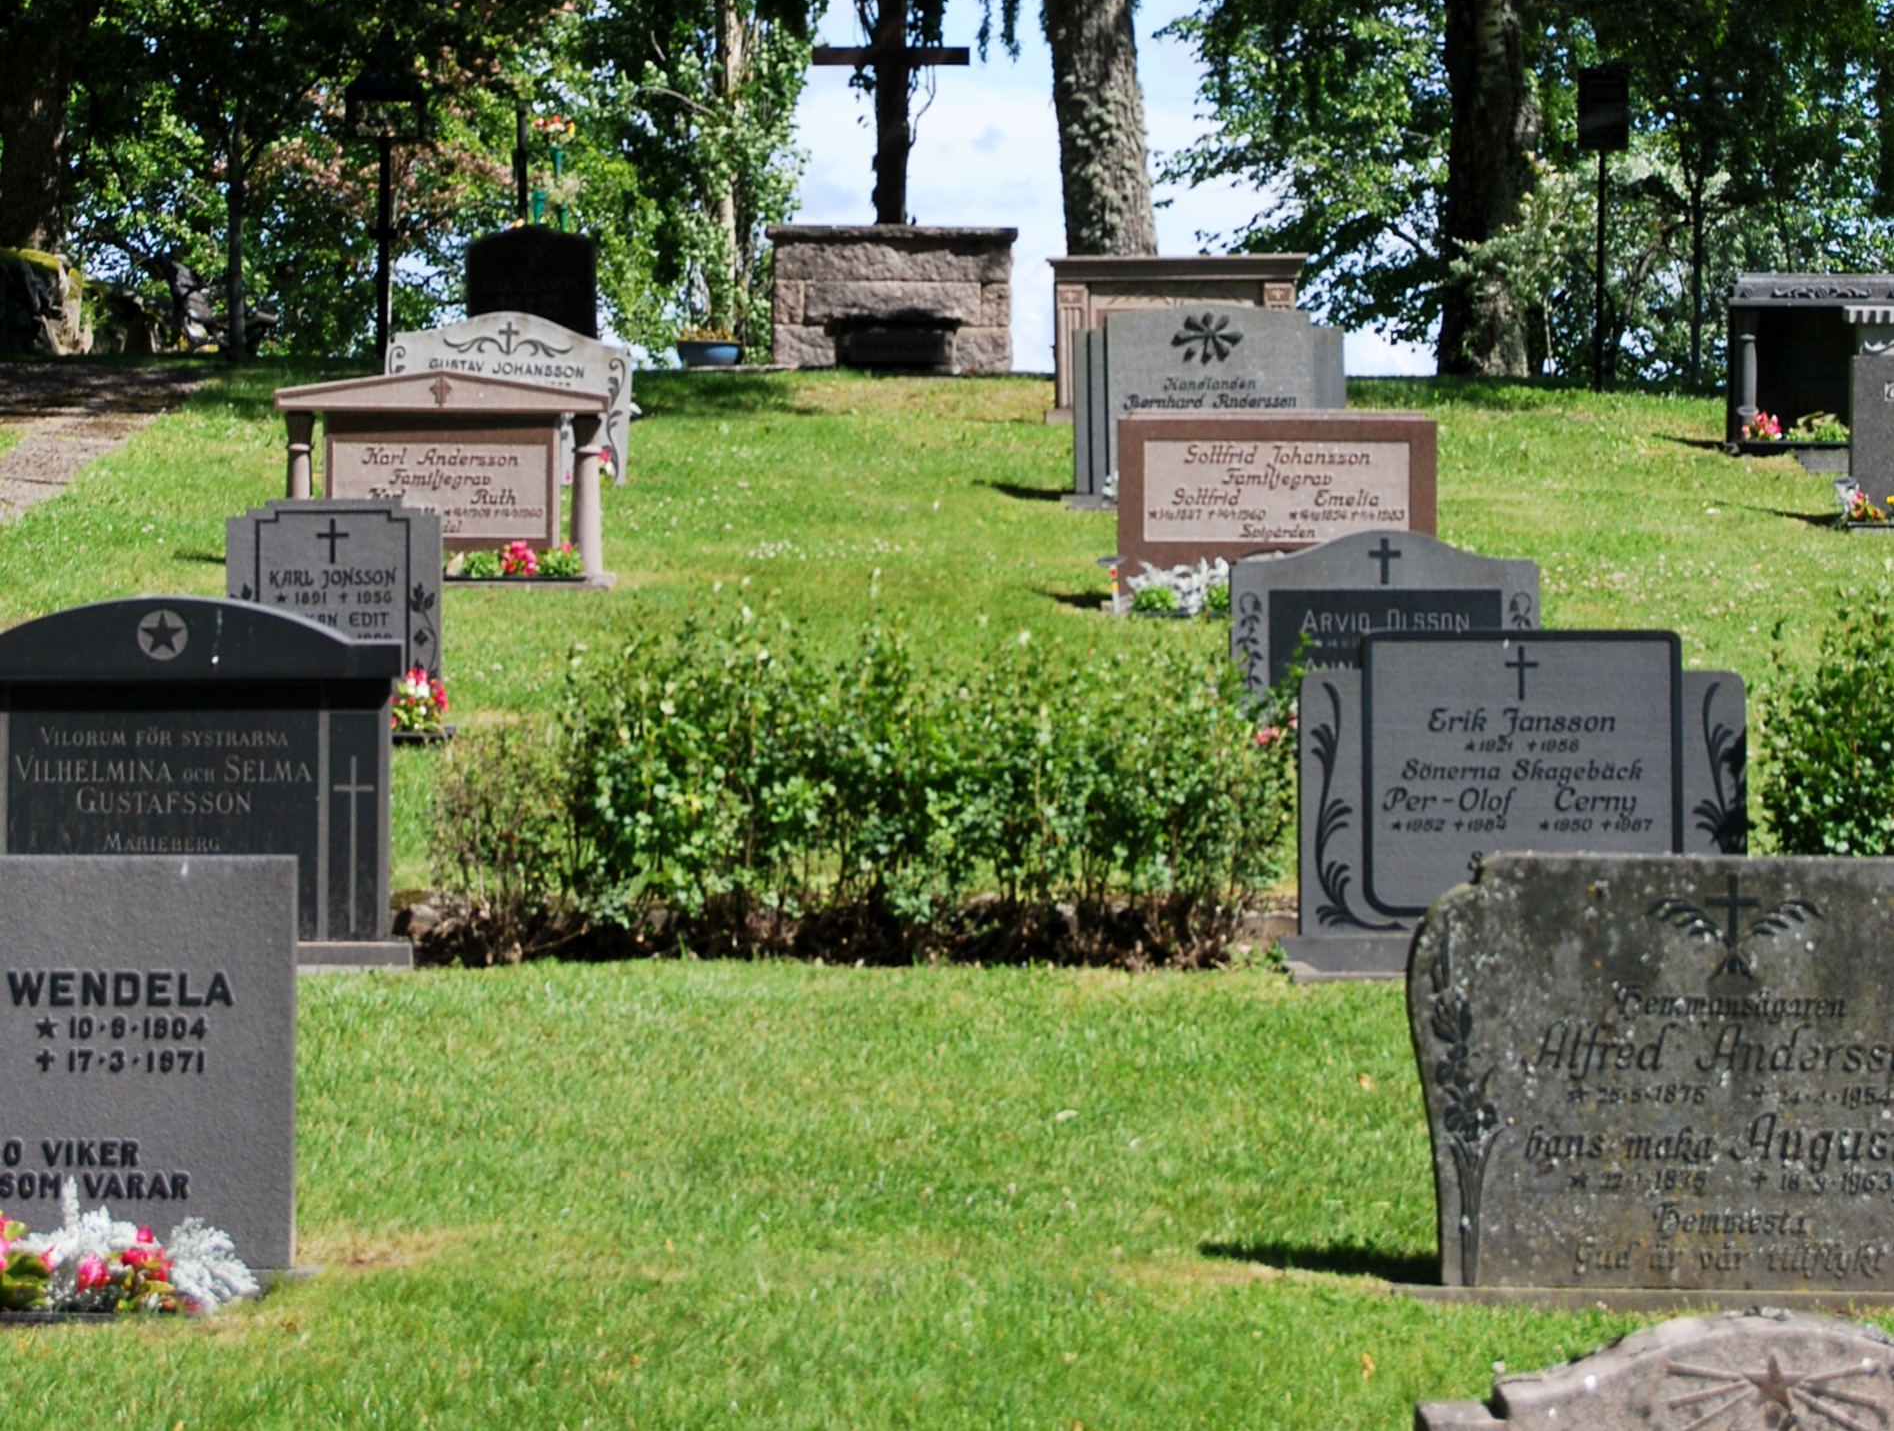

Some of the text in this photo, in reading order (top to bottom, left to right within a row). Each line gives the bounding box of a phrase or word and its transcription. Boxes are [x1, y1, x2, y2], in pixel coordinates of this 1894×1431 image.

[429, 357, 585, 380] GUSTAV JOHANSSON
[362, 447, 519, 466] Karl Andersson
[1183, 444, 1371, 468] Gottfrid Johansson
[389, 468, 491, 491] Familjegrav
[1222, 468, 1332, 490] Familjegrav
[470, 488, 516, 505] Ruth
[1172, 488, 1242, 506] Gottfrid
[269, 567, 398, 589] KARL JONSSON
[295, 591, 393, 604] 1891 1956
[349, 612, 390, 627] EDIT
[1300, 608, 1470, 633] ARVID OLSSON
[1427, 707, 1616, 743] Erik Jansson
[1401, 757, 1643, 789] Sönerna Skagebäck
[76, 785, 252, 815] GUSTAFSSON
[1554, 787, 1638, 819] Cerny
[7, 970, 237, 1007] WENDELA
[1523, 1020, 1894, 1080] Alfred Anderss
[4, 1136, 140, 1167] O VIKER
[1626, 1124, 1714, 1164] maka
[1728, 1112, 1894, 1171] Augus
[0, 1170, 192, 1200] SOM VARAR
